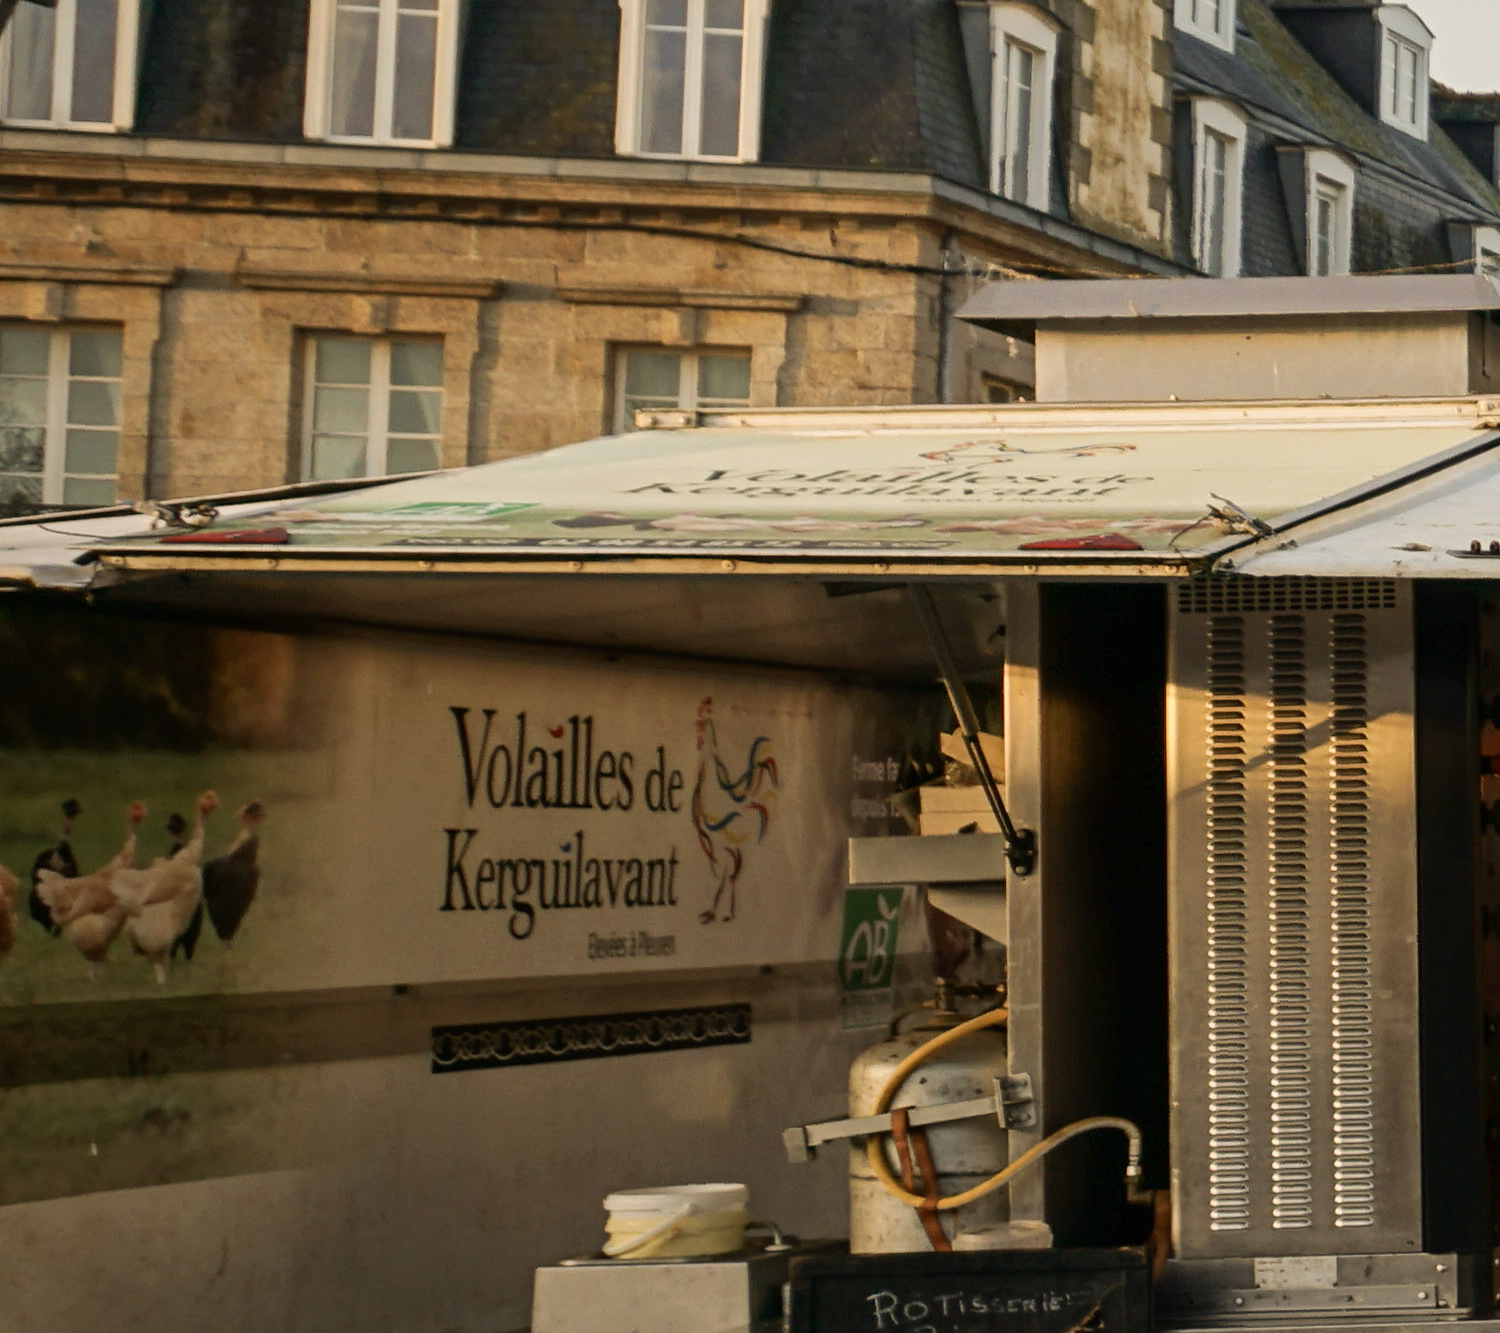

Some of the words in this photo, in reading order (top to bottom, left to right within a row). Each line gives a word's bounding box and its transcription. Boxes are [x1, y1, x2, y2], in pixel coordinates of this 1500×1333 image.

[450, 706, 634, 812] Volailles
[645, 745, 683, 812] de
[440, 828, 680, 939] Kerguilavant
